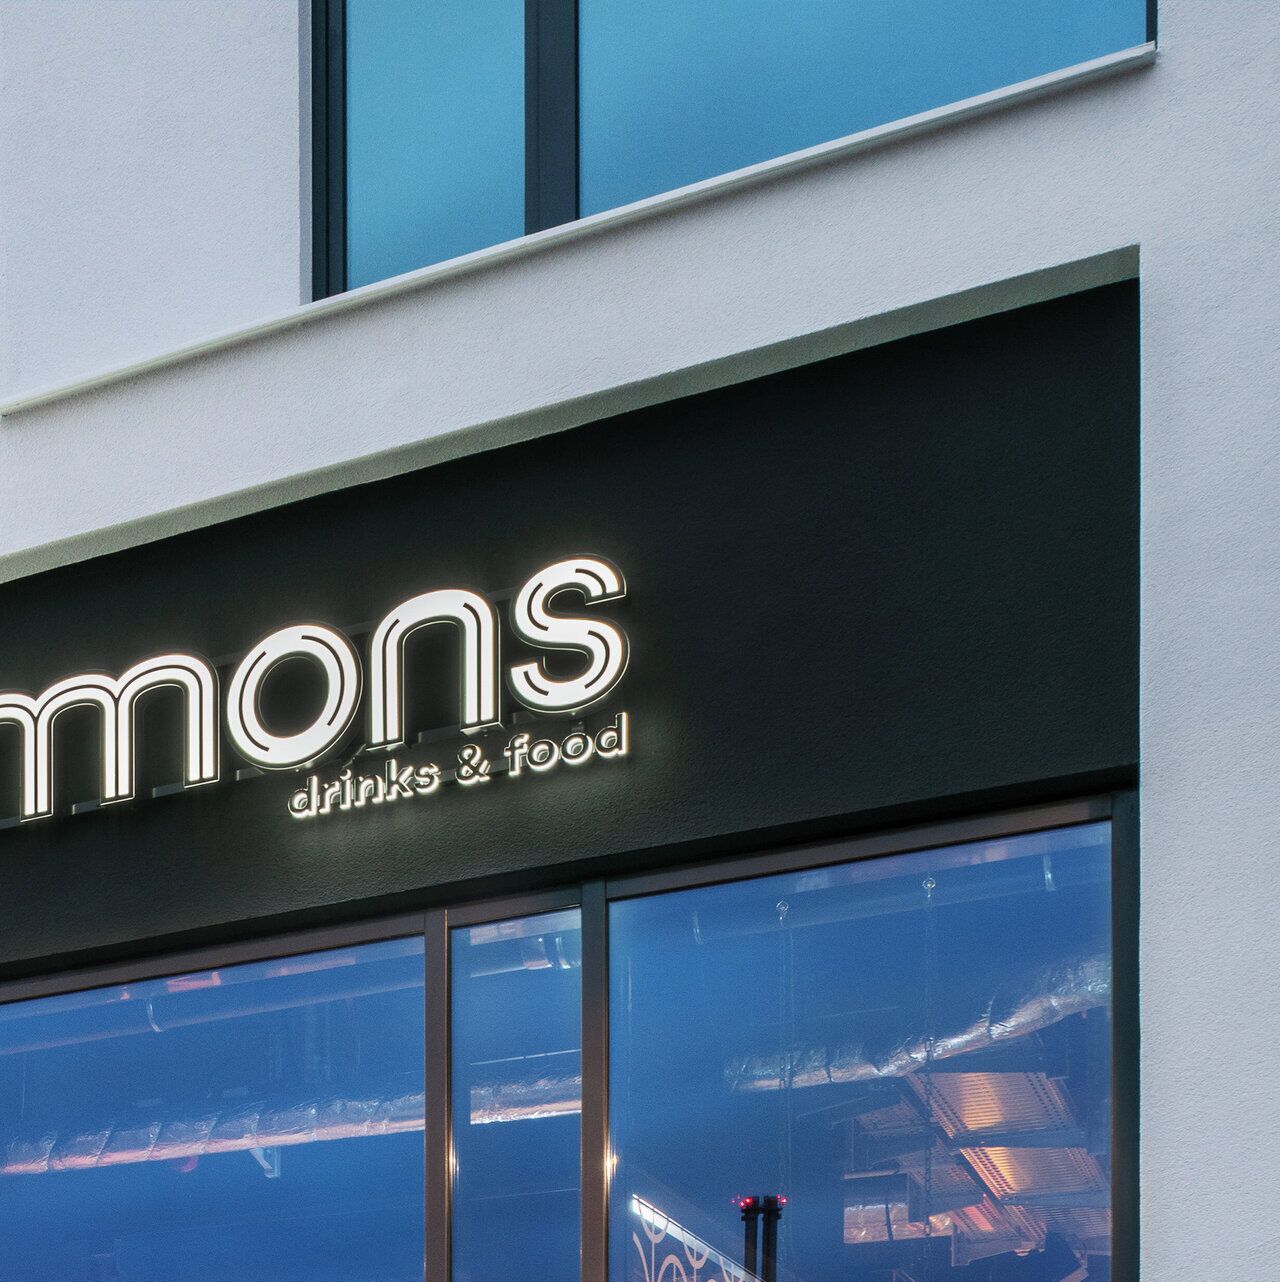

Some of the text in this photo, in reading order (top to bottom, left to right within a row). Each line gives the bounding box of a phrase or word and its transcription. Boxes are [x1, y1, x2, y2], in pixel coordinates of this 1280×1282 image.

[288, 711, 628, 817] drinks & food
